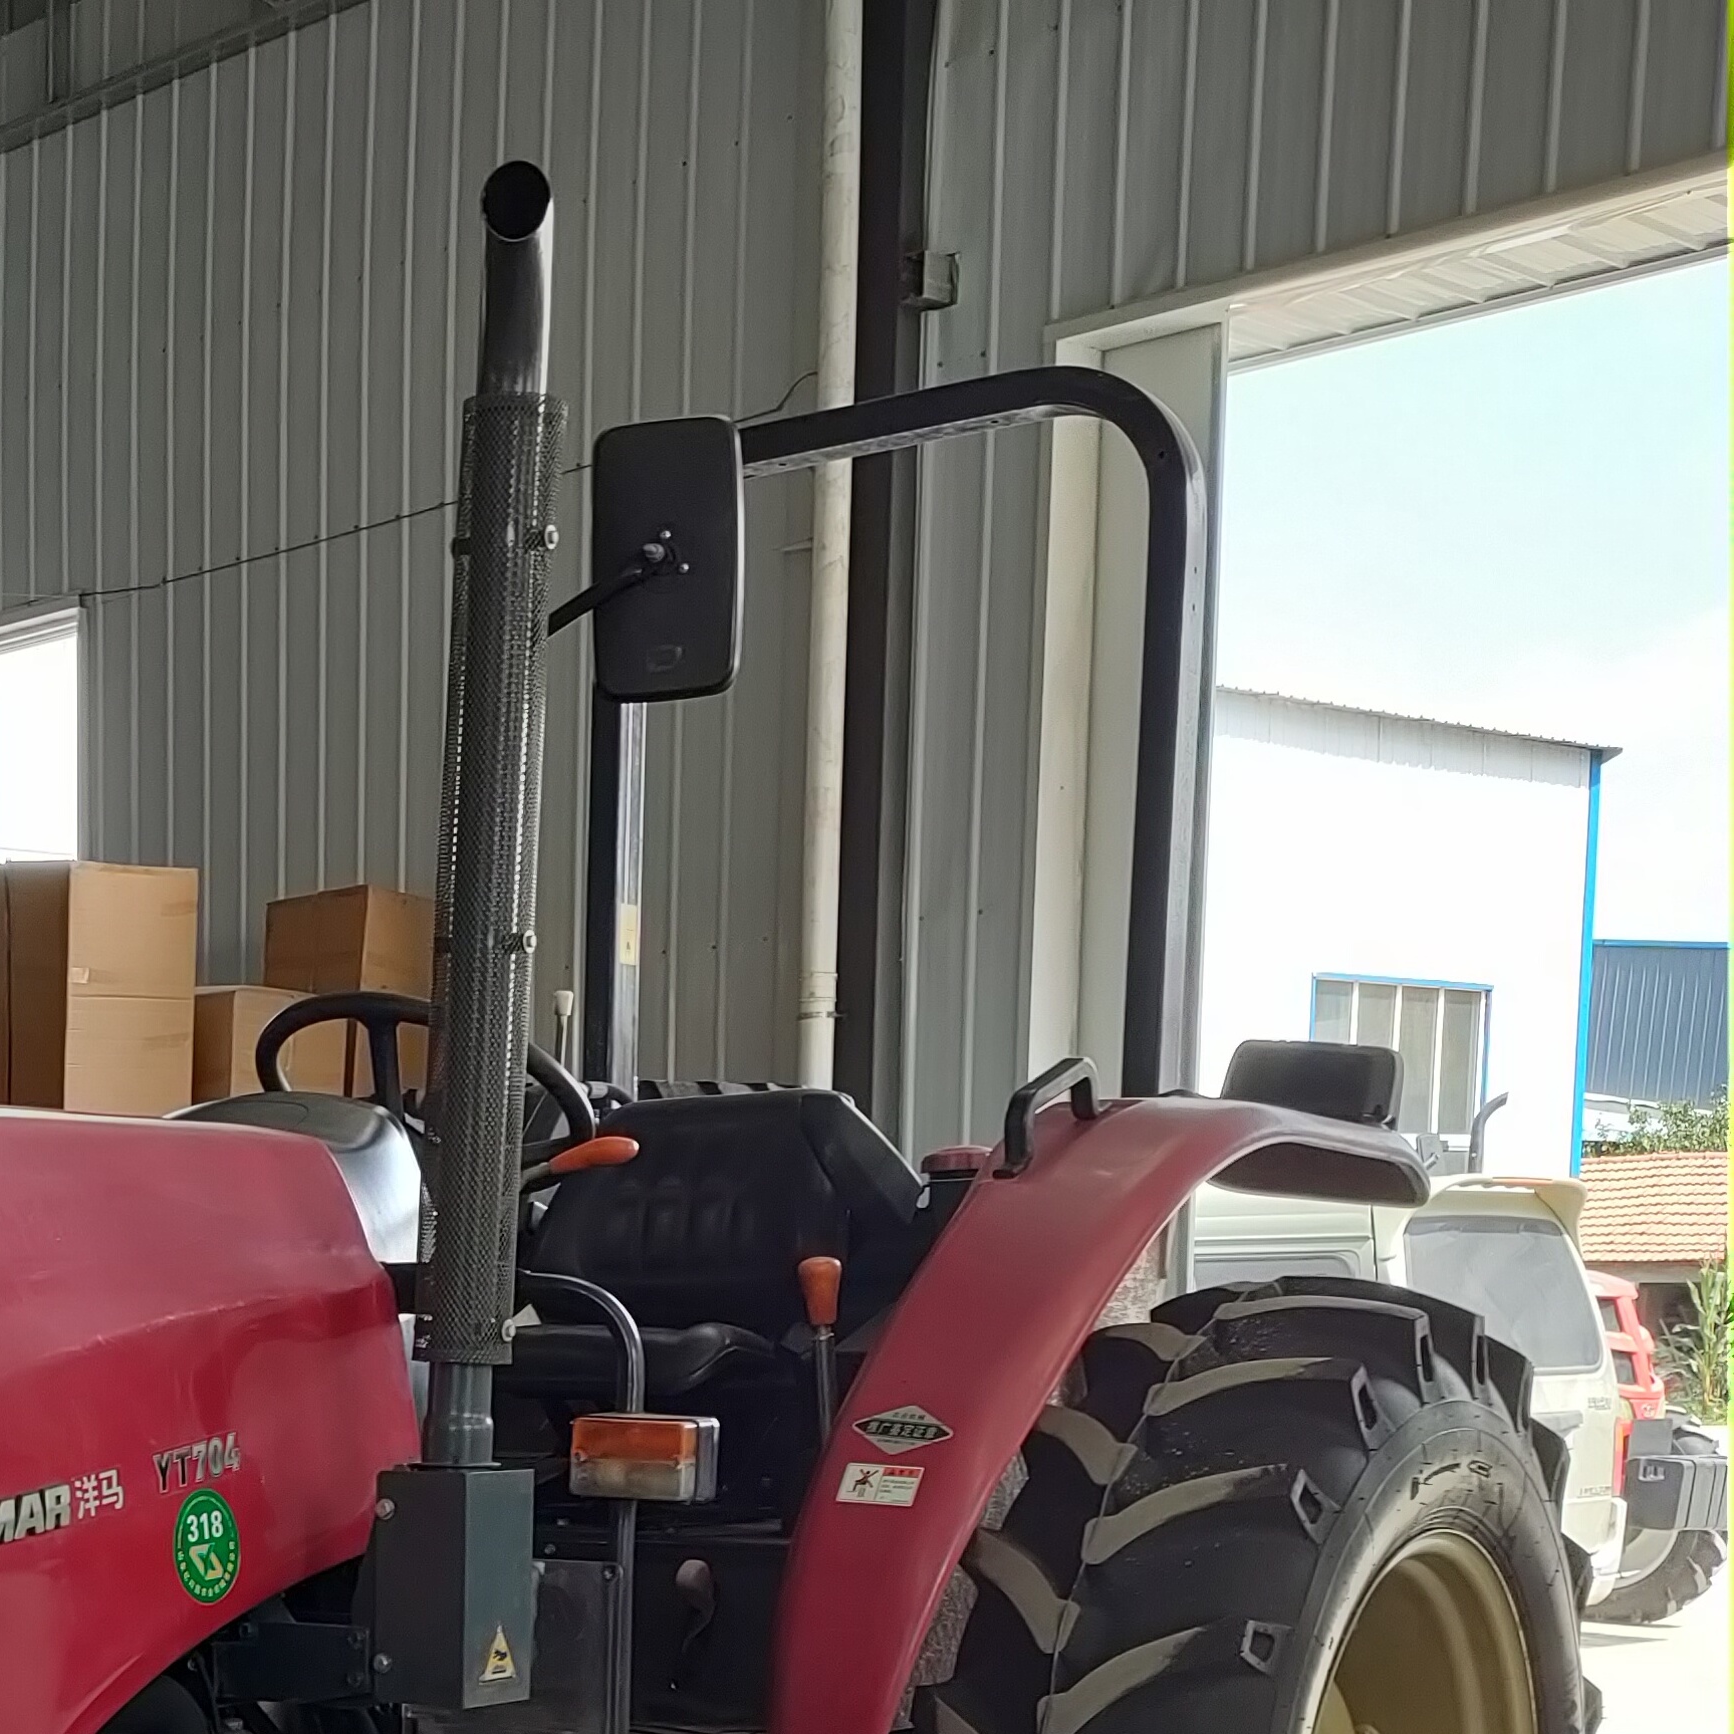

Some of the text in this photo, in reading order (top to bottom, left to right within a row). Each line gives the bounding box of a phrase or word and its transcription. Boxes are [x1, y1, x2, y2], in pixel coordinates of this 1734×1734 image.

[152, 1432, 240, 1494] YT704
[73, 1468, 125, 1521] 洋马
[185, 1510, 224, 1543] 318
